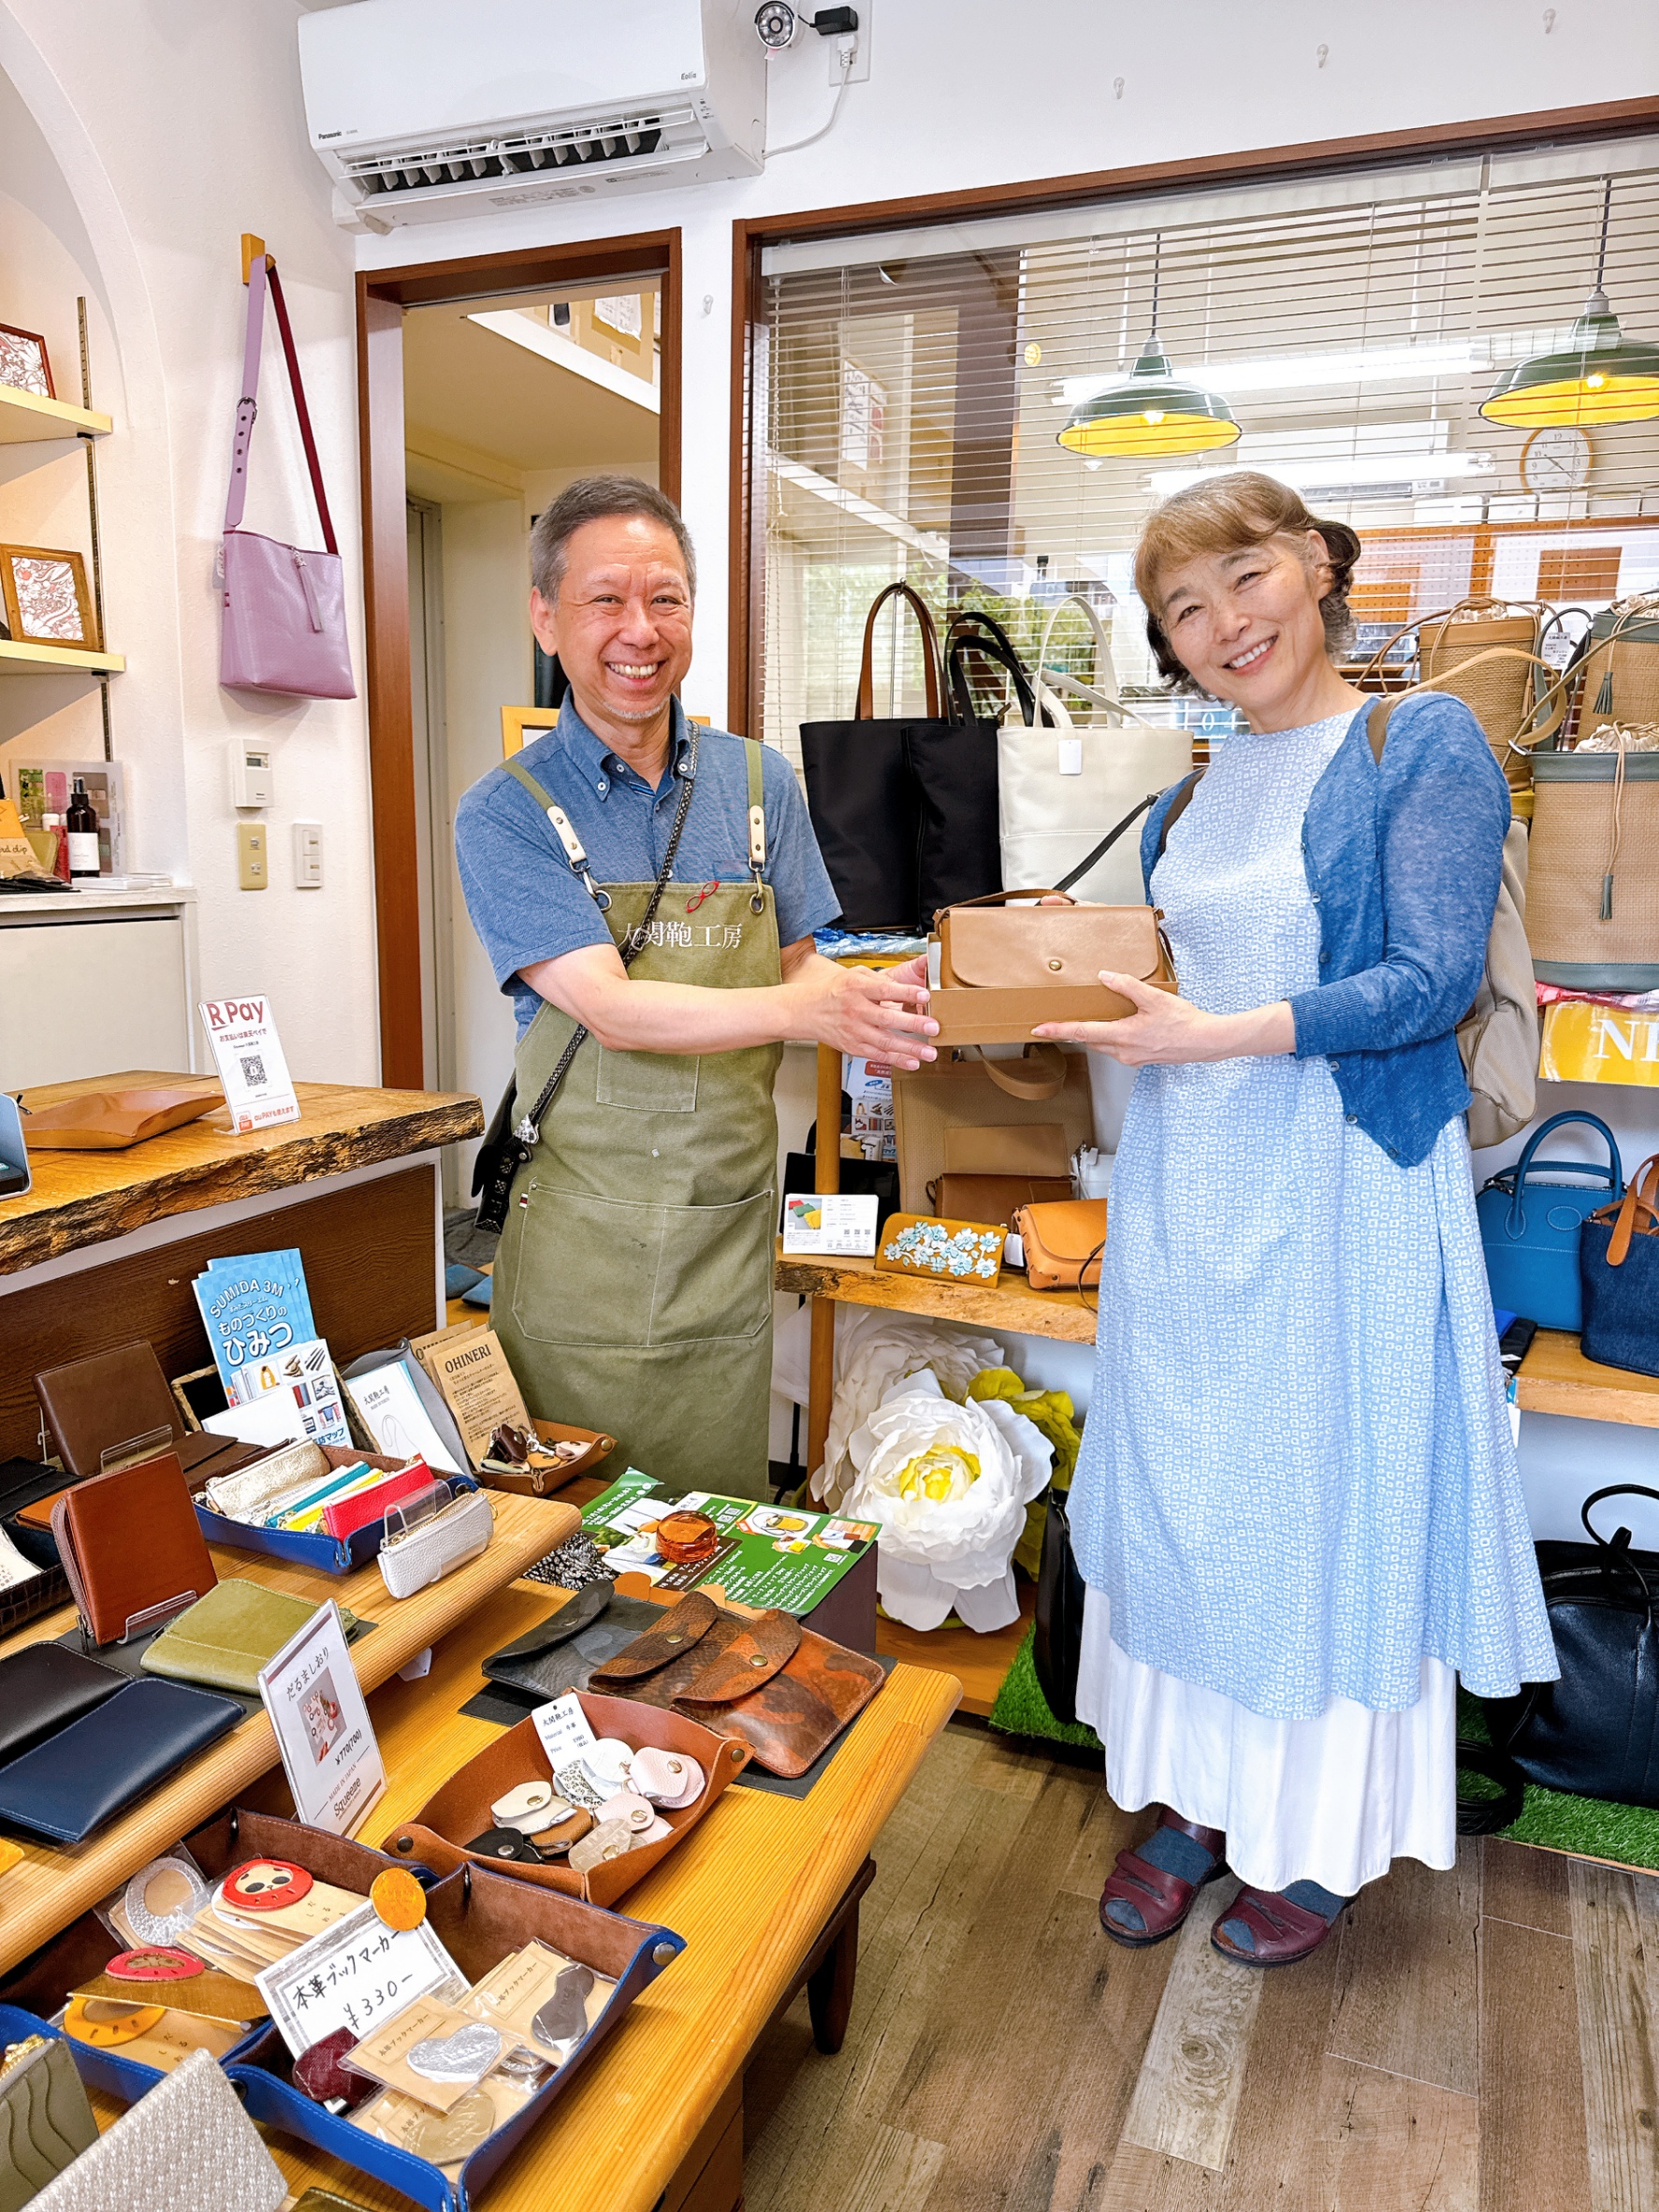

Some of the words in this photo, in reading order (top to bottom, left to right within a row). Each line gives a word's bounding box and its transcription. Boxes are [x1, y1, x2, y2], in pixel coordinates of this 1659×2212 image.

[318, 131, 342, 139] Panasonic
[210, 1278, 261, 1318] SUMIDA
[263, 1280, 284, 1298] 3M
[218, 1304, 288, 1336] ものづくりの
[222, 1321, 295, 1366] ひみつ
[444, 1344, 492, 1373] OHINERI
[286, 1647, 328, 1701] だるましおり
[333, 1777, 362, 1818] Squeeze
